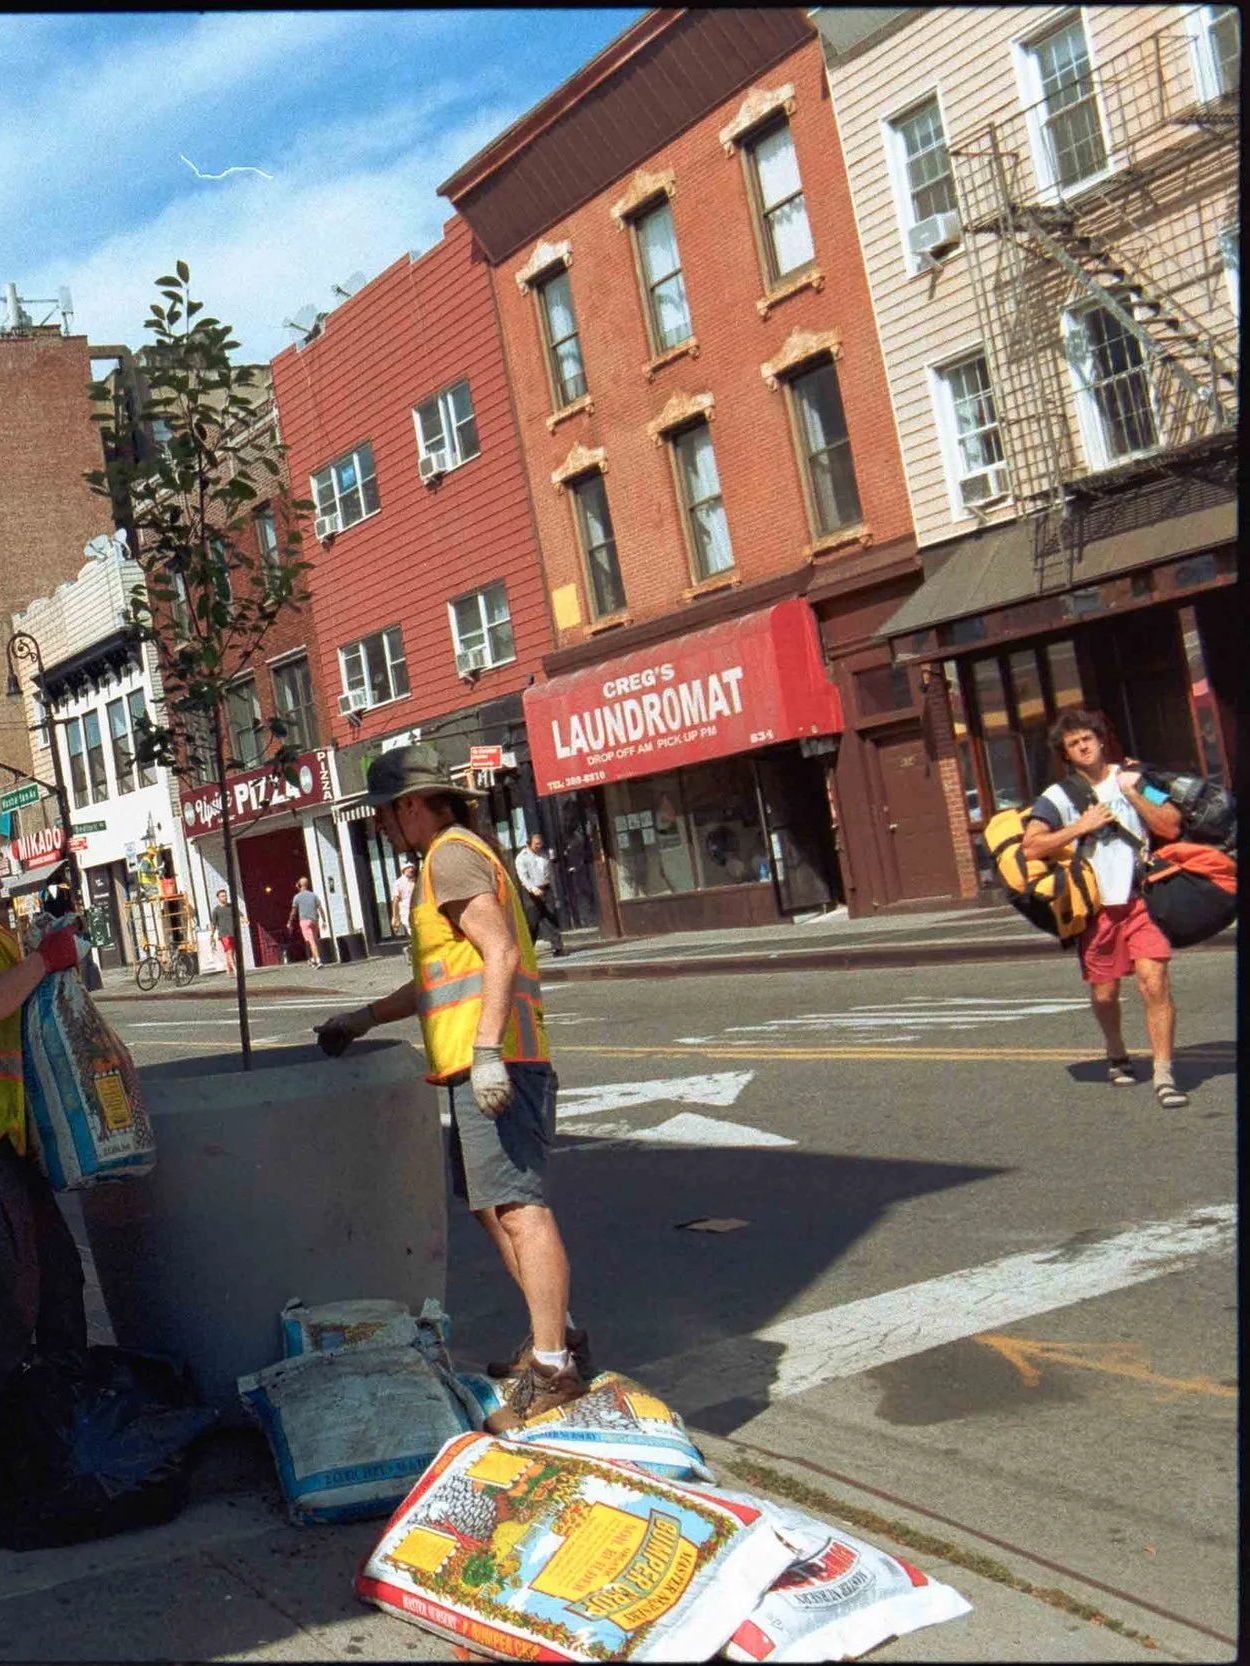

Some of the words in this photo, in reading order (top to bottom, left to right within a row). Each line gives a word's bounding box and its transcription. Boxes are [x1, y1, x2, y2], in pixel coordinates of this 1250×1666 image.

[551, 665, 744, 760] LAUNDROMAT
[586, 750, 615, 766] DROP
[616, 746, 636, 759] OFF
[638, 741, 654, 754] AM
[656, 734, 682, 749] PICK
[683, 730, 698, 743] UP
[700, 725, 718, 738] PM
[316, 751, 333, 801] PIZZA
[17, 826, 62, 861] MIKADO
[571, 1547, 619, 1592] BUILDER
[624, 1517, 679, 1592] BUMPER
[664, 1550, 693, 1594] MASTER
[584, 1584, 640, 1617] CROP
[622, 1592, 672, 1624] NURSERY
